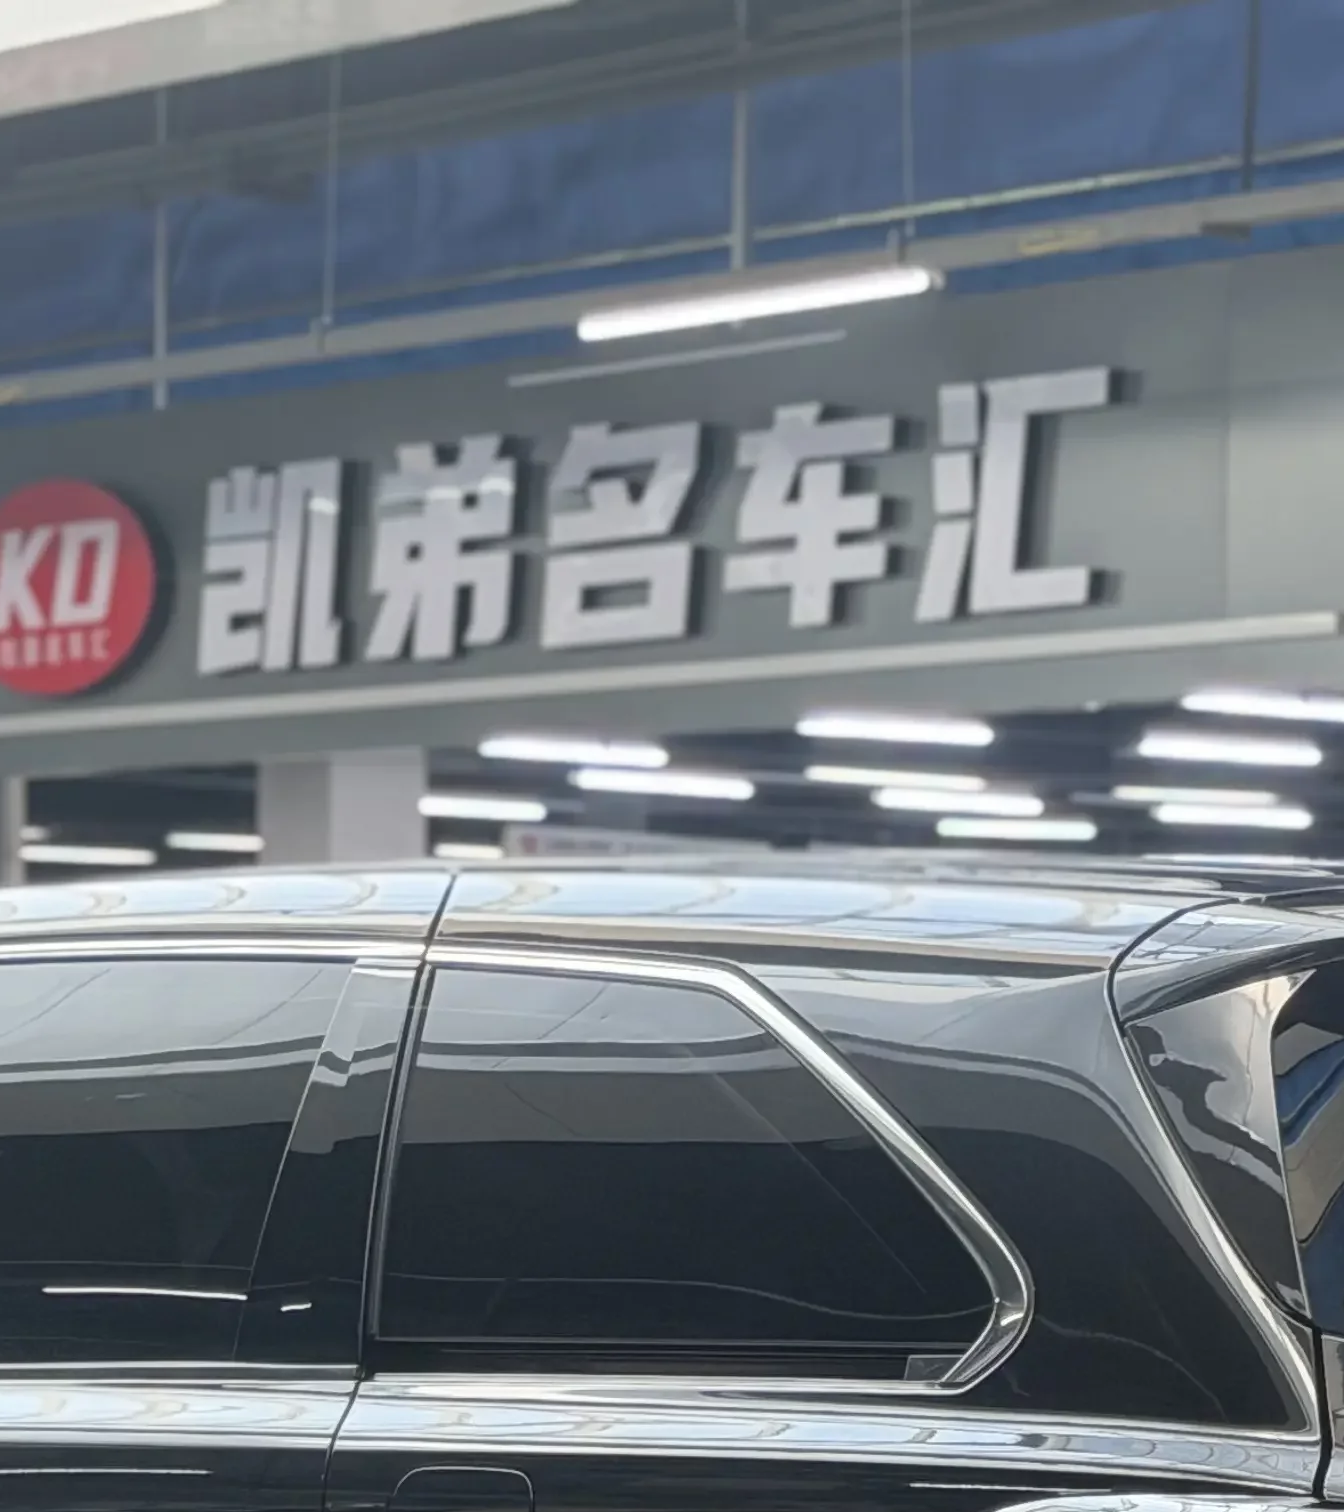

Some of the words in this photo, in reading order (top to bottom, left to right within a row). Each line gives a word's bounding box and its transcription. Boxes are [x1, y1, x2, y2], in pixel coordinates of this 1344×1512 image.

[197, 366, 1110, 676] 凯弟名车汇
